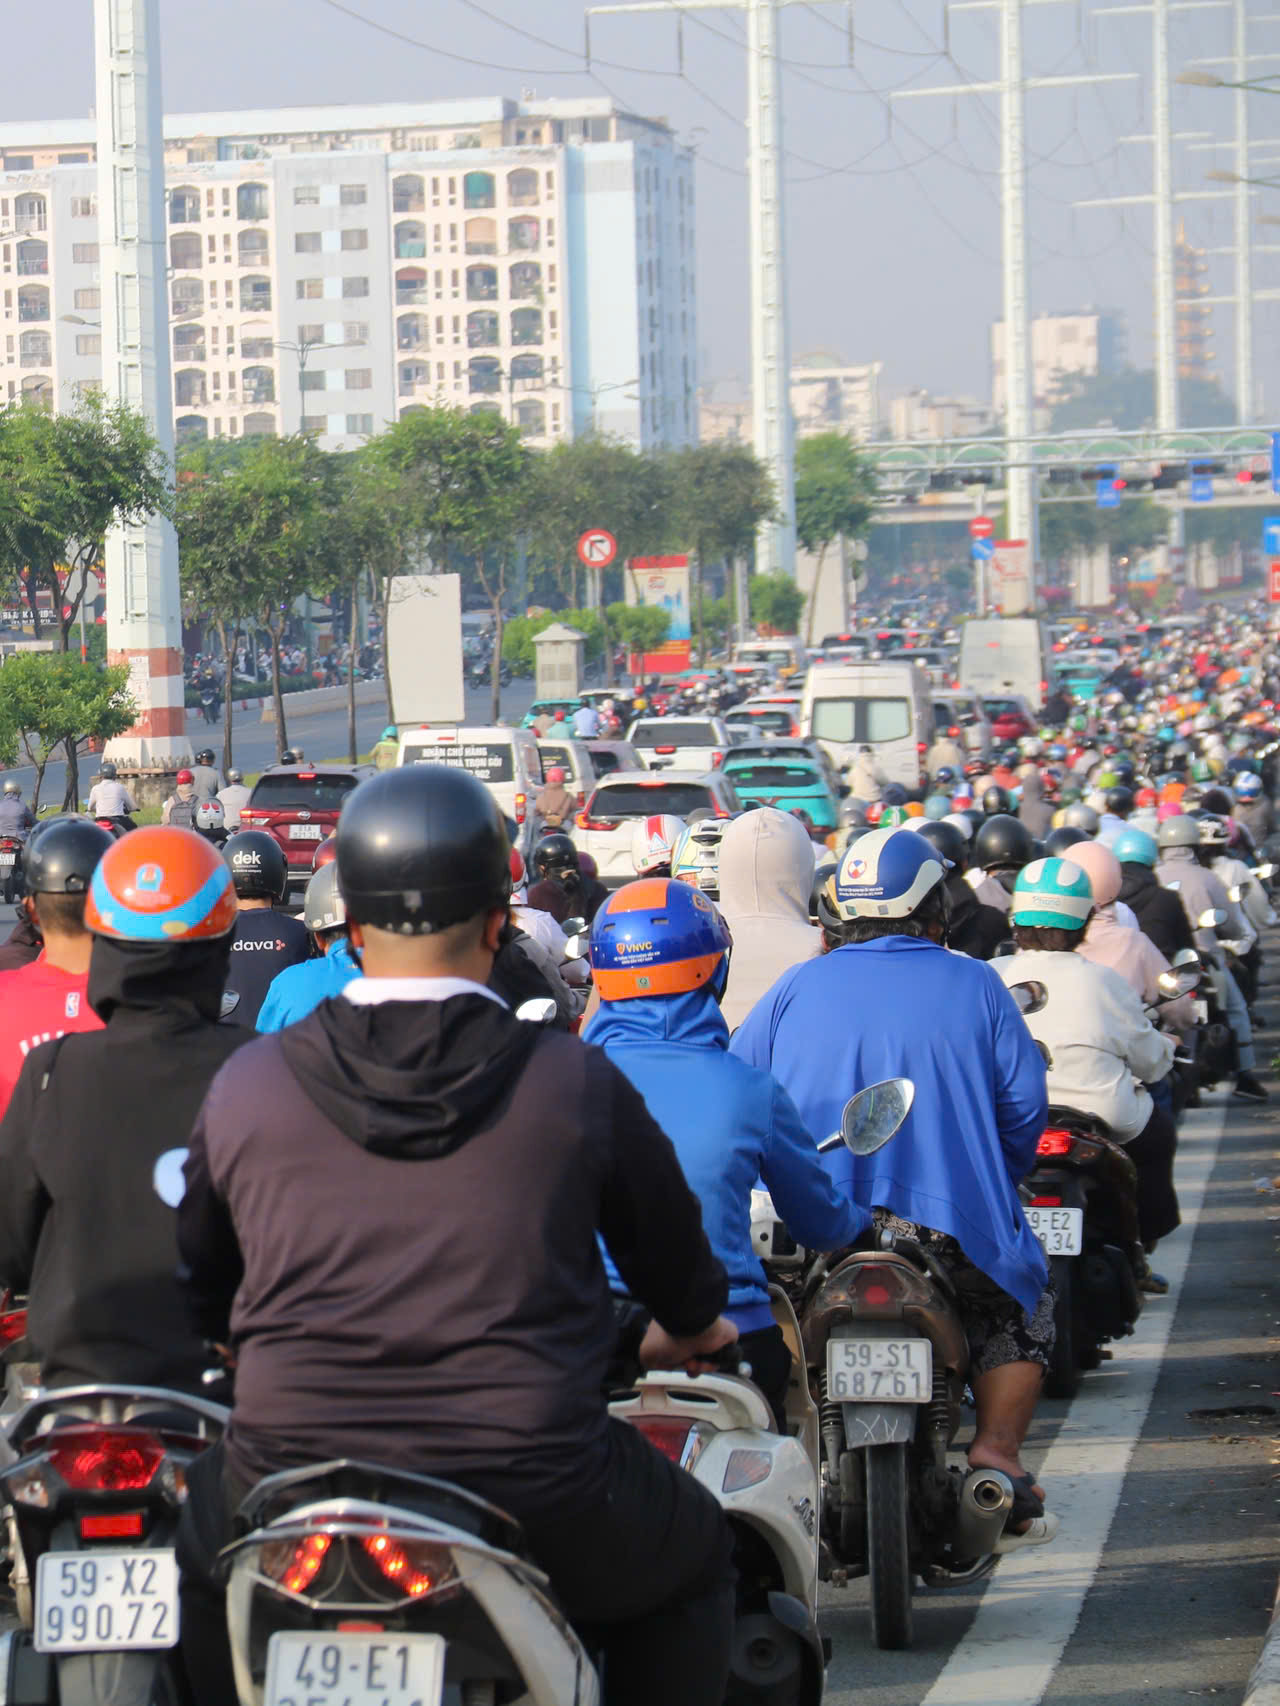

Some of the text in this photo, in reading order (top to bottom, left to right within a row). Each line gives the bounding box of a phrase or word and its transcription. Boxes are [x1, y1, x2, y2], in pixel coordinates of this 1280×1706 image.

[233, 850, 261, 865] dek
[230, 939, 274, 951] dava
[626, 941, 653, 952] VNVC
[844, 1343, 913, 1368] 59-S1
[834, 1371, 921, 1398] 687.61
[60, 1558, 157, 1598] 59-X2
[47, 1600, 169, 1642] 990.72
[295, 1645, 410, 1691] 49-E1
